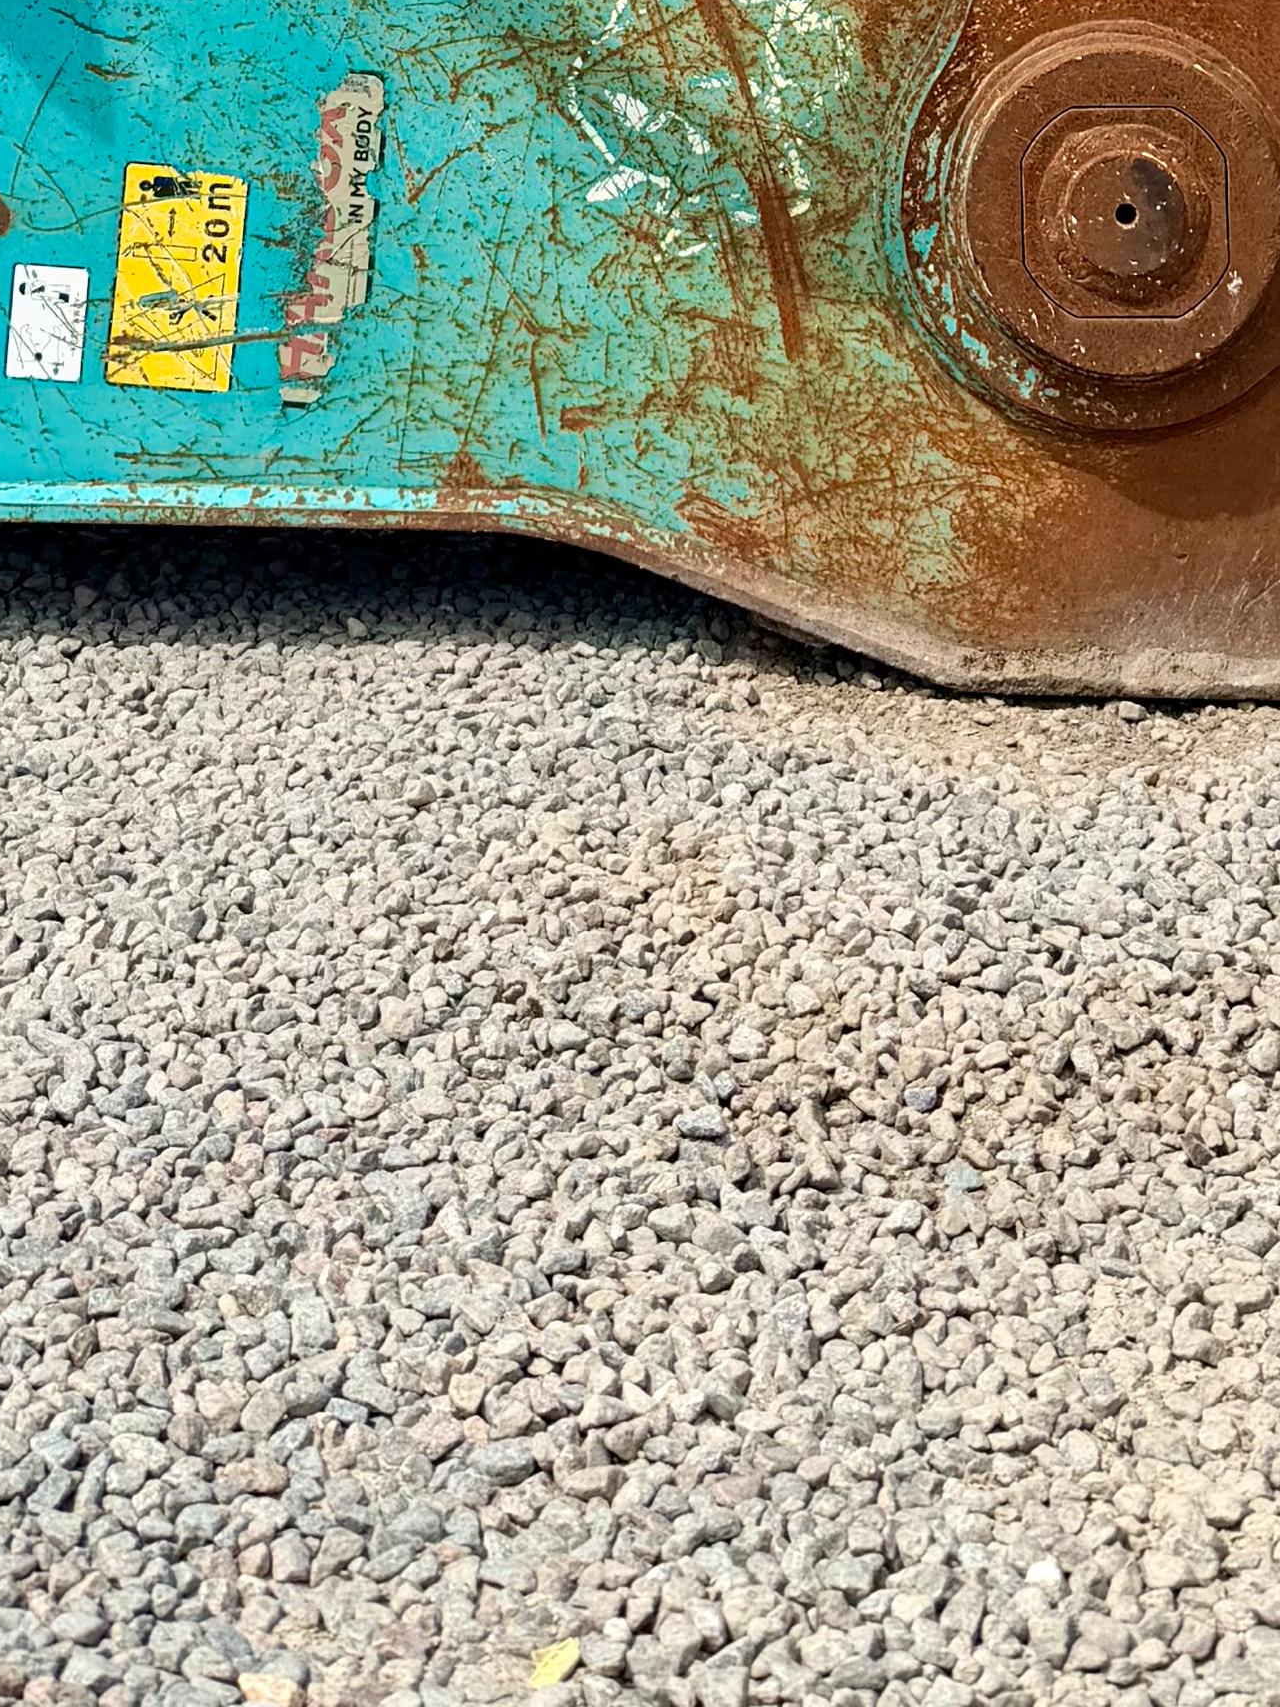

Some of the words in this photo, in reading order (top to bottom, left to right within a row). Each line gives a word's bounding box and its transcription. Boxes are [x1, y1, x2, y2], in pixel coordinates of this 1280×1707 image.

[353, 105, 374, 162] BODY
[348, 168, 370, 198] MY
[347, 203, 366, 225] IN
